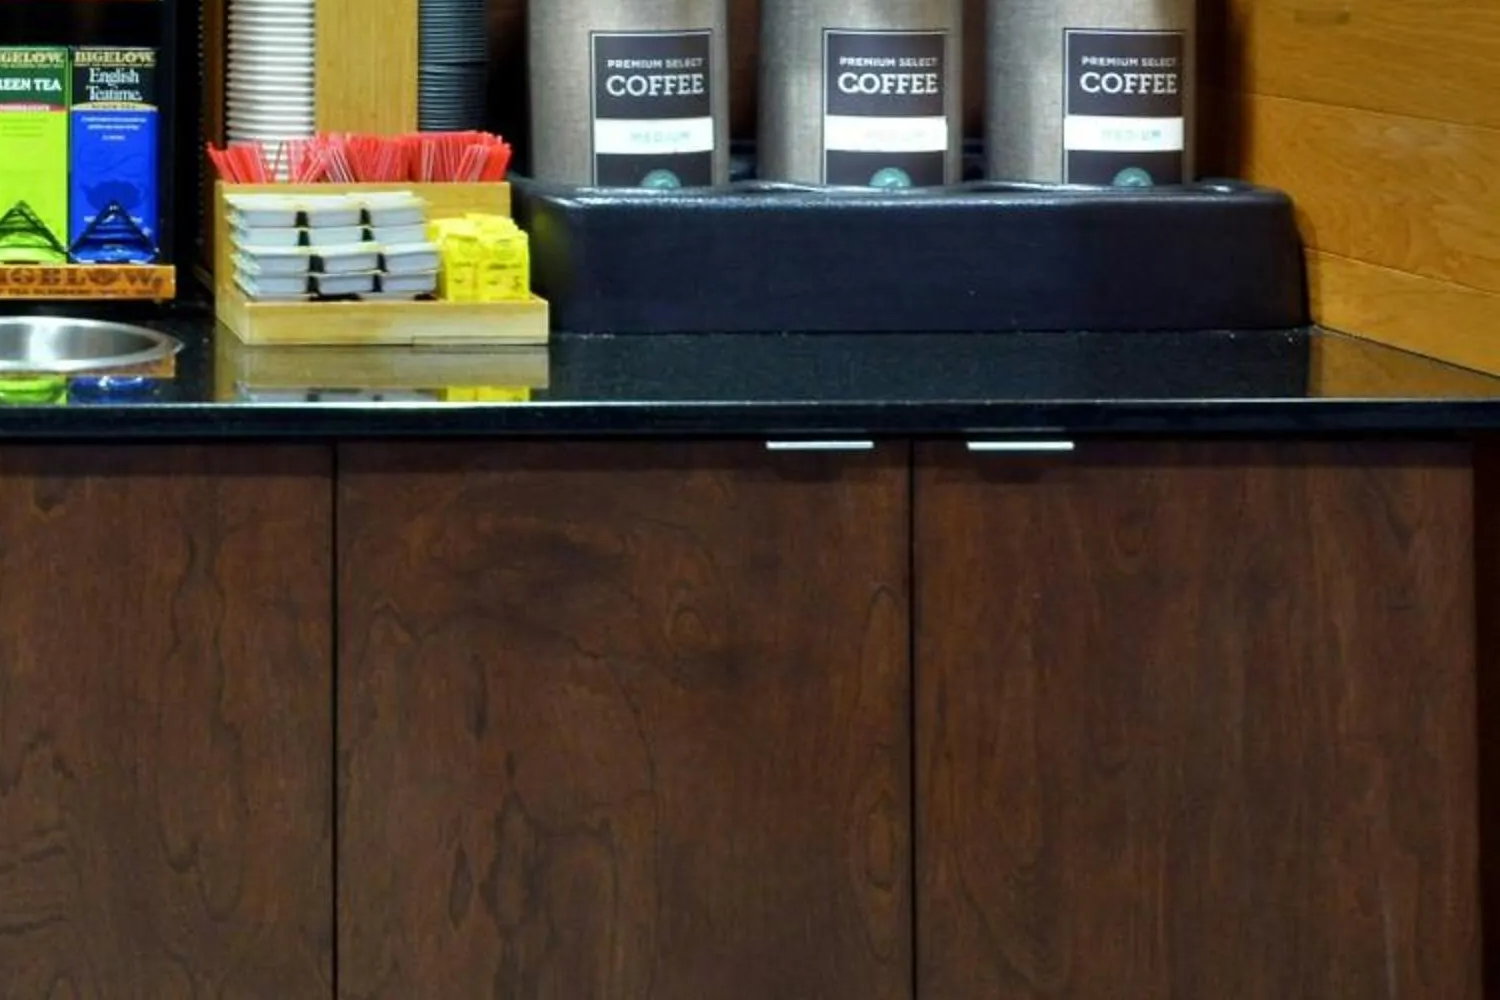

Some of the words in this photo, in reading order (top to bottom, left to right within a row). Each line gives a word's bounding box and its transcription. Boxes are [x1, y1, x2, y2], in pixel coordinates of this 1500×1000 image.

[607, 59, 662, 69] PREMIUM
[665, 57, 704, 69] SELECT
[839, 56, 895, 67] PREMIUM
[899, 57, 938, 67] SELECT
[1081, 55, 1138, 67] PREMIUM
[1141, 56, 1176, 67] SELECT
[34, 77, 62, 91] TEA
[89, 67, 139, 87] English
[605, 73, 704, 96] COFFEE
[837, 72, 939, 94] COFFEE
[1080, 71, 1177, 94] COFFEE
[85, 85, 140, 101] Teatime
